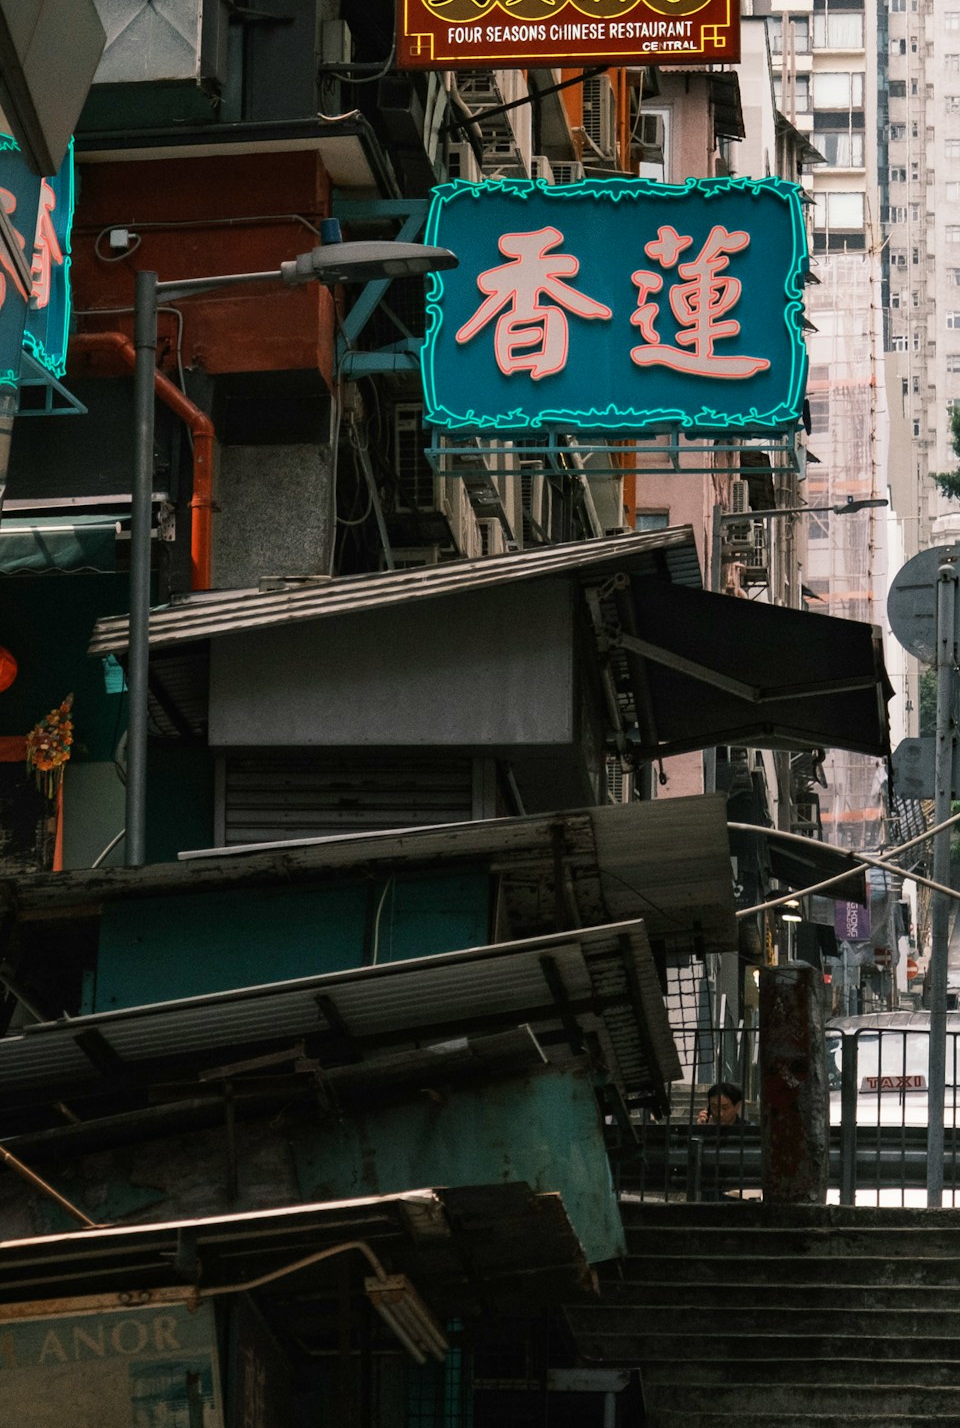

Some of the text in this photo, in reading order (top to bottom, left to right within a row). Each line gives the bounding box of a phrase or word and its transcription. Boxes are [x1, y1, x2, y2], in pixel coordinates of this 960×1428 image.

[448, 21, 693, 44] FOUR SEASONS CHINESE RESTAURANT
[642, 40, 698, 51] CENTRAL
[850, 910, 858, 938] KONG
[867, 1075, 922, 1089] TAXI
